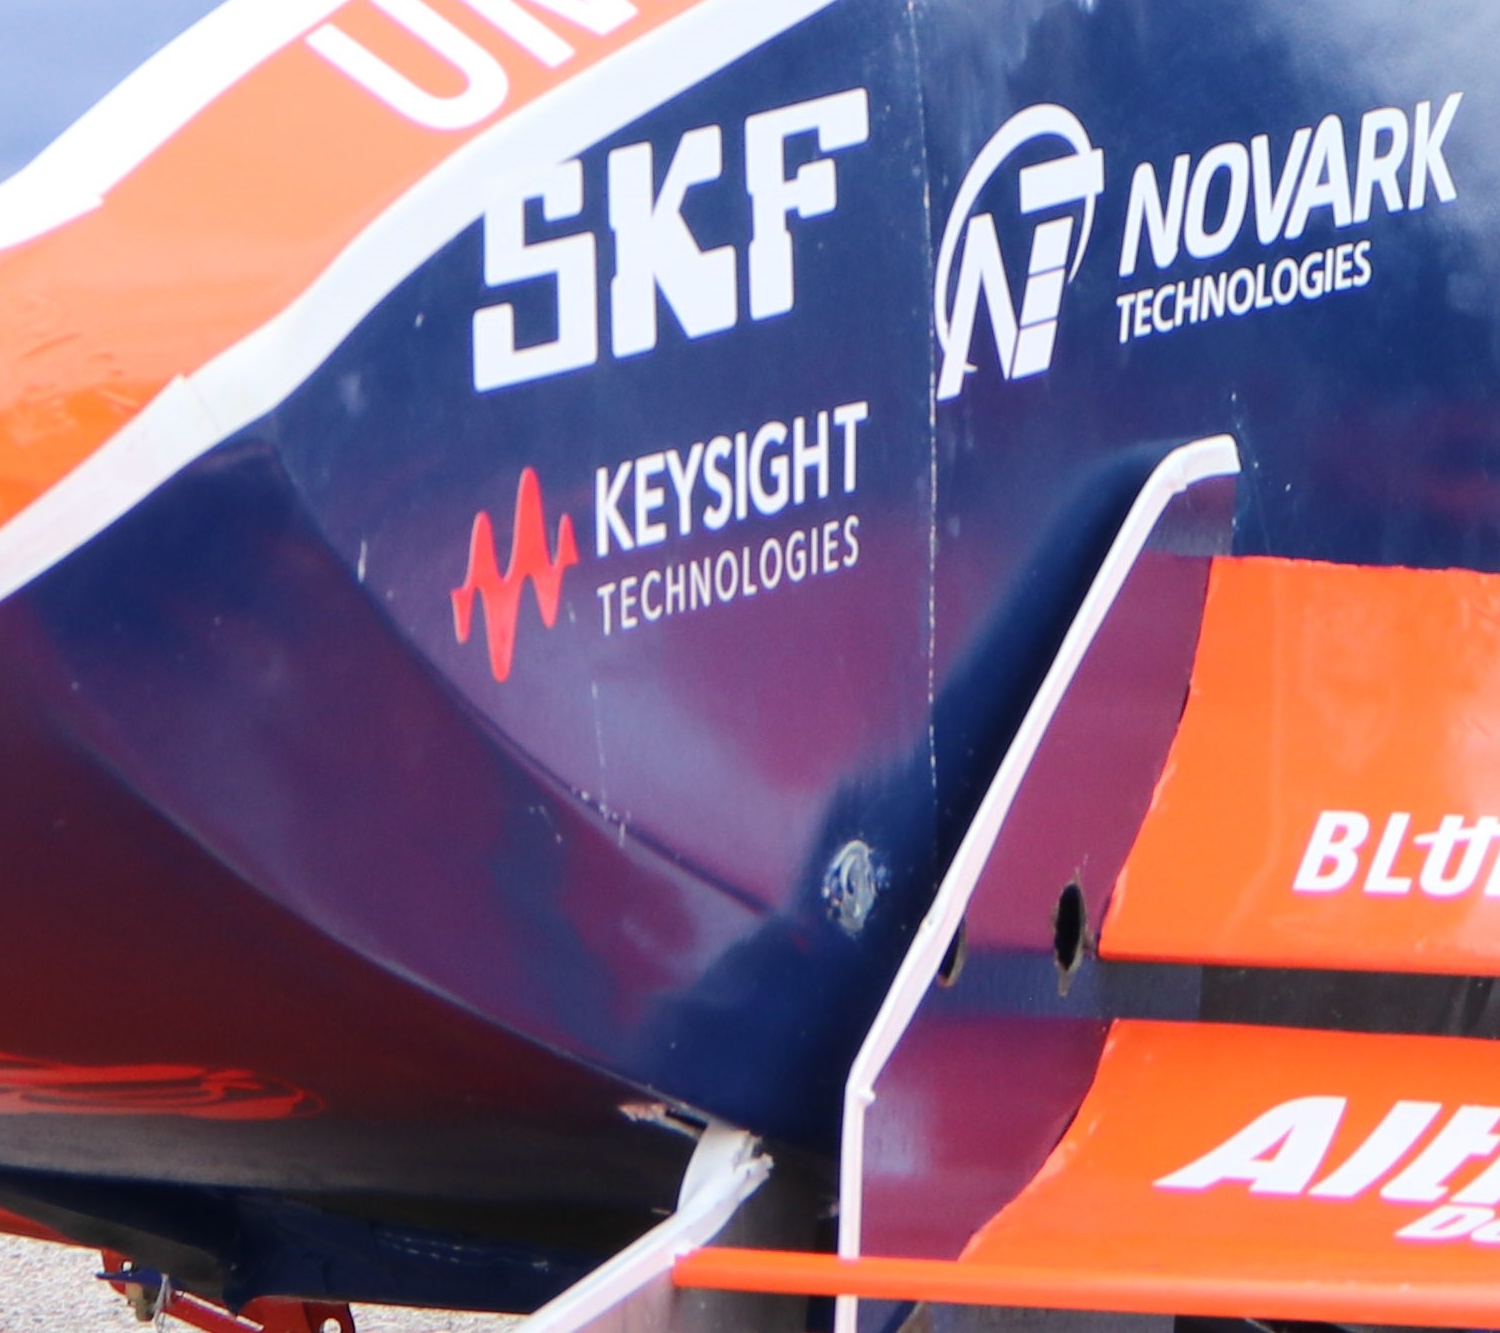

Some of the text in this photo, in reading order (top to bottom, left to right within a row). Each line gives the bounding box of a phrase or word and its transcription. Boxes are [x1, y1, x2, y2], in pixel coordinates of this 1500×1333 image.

[472, 86, 870, 394] SKF
[1118, 91, 1465, 277] NOVARK
[1115, 238, 1373, 344] TECHNOLOGIES
[596, 401, 869, 559] KEYSIGHT
[596, 514, 861, 637] TECHNOLOGIES
